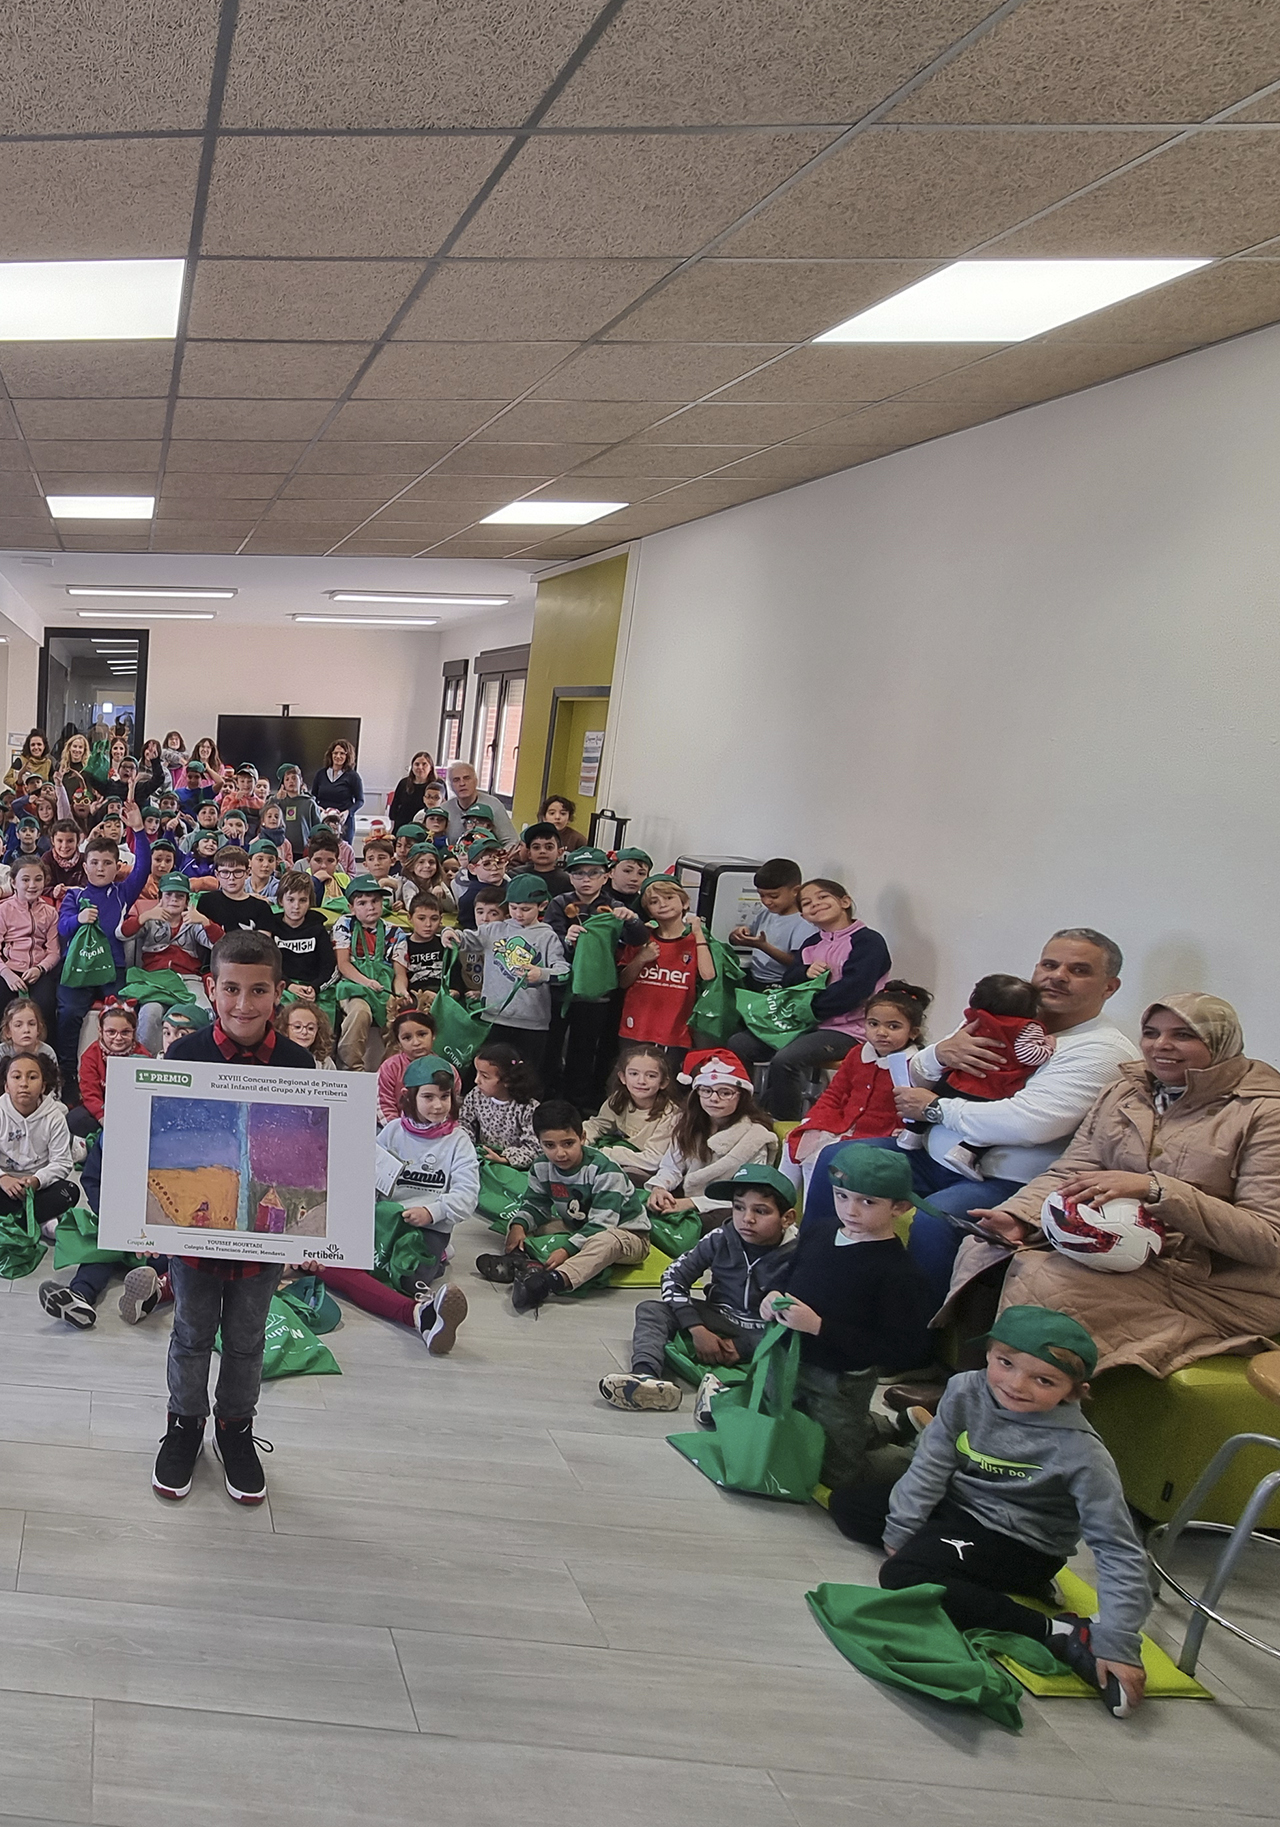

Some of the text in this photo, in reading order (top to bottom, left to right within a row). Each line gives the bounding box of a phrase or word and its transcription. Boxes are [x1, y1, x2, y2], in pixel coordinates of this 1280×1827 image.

[410, 951, 440, 963] STREET
[639, 964, 691, 984] osner
[443, 1045, 463, 1068] Grupo
[150, 1073, 189, 1084] PREMIO
[218, 1074, 241, 1082] XXVIII
[242, 1075, 277, 1084] Concurso
[278, 1078, 310, 1087] Regional
[321, 1081, 348, 1089] Pintura
[231, 1083, 257, 1091] Infantil
[271, 1086, 294, 1095] Grupo
[313, 1089, 348, 1097] Fertiberia
[303, 1249, 344, 1260] Fertiberia
[265, 1325, 289, 1340] rupo
[1008, 1469, 1026, 1478] DO
